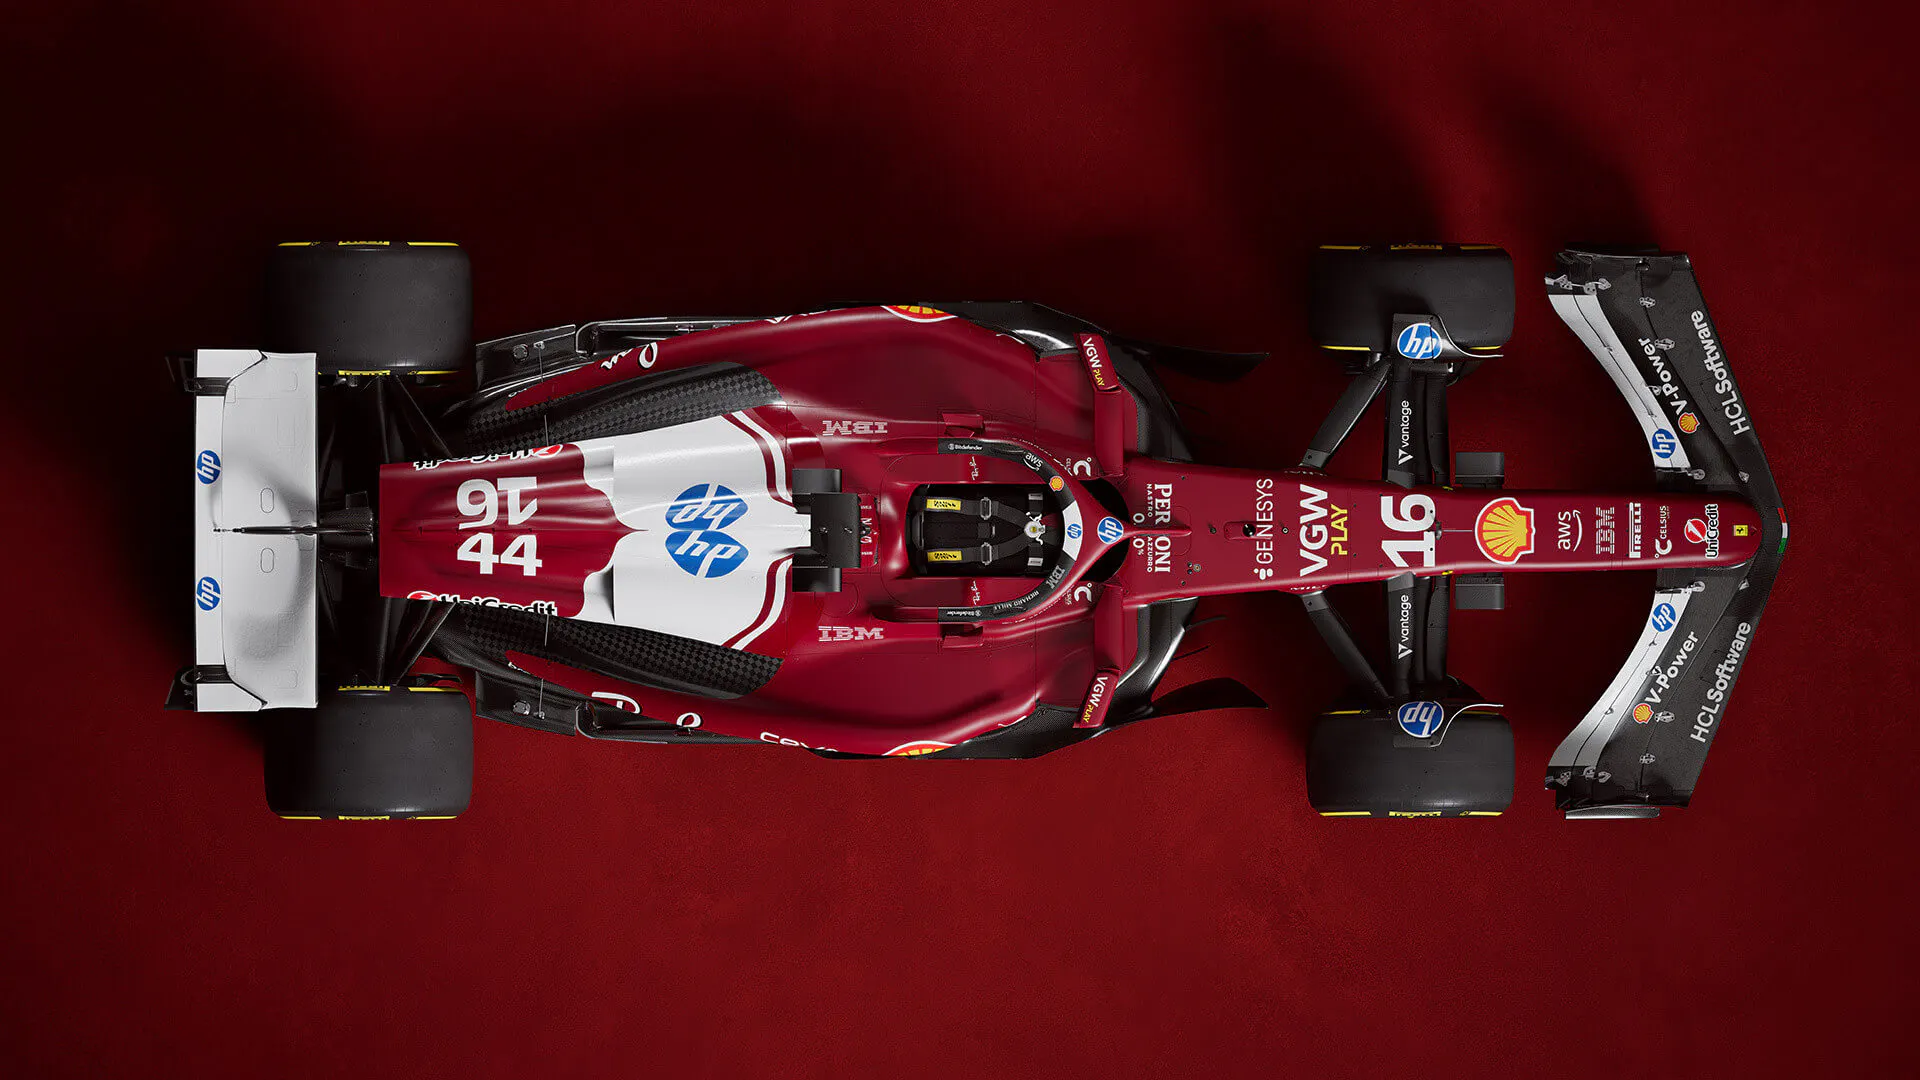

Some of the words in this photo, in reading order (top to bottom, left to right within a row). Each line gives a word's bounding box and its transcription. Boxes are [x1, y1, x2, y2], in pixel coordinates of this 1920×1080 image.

[1083, 337, 1102, 368] VGW
[1400, 324, 1439, 359] hp
[1092, 368, 1105, 386] PLAY
[1638, 338, 1687, 415] V-Power
[1690, 309, 1750, 436] HCLSoftware
[822, 420, 888, 436] IBM
[1400, 400, 1412, 448] vantage
[1652, 430, 1676, 456] hp
[197, 451, 221, 483] hp
[1025, 452, 1044, 469] aws
[456, 476, 538, 530] 16
[667, 483, 745, 530] hp
[1256, 478, 1274, 565] GENESYS
[1659, 505, 1668, 539] CELSIUS
[1098, 518, 1123, 543] hp
[1299, 483, 1328, 577] VGW
[1330, 503, 1348, 556] PLAY
[1380, 494, 1436, 568] 16
[1557, 511, 1571, 550] aws
[1595, 507, 1615, 555] IBM
[1629, 502, 1642, 559] PIRELLI
[1704, 503, 1719, 559] UniCredit
[456, 532, 543, 577] 44
[667, 531, 745, 578] hp
[197, 577, 221, 610] hp
[1046, 564, 1066, 589] IBM
[818, 626, 884, 642] IBM
[1400, 594, 1412, 643] vantage
[1652, 604, 1675, 631] hp
[1644, 631, 1698, 704] V-Power
[1690, 621, 1751, 743] HCLSoftware
[1089, 676, 1108, 708] VGW
[1083, 704, 1094, 723] PLAY
[1400, 702, 1440, 736] hp
